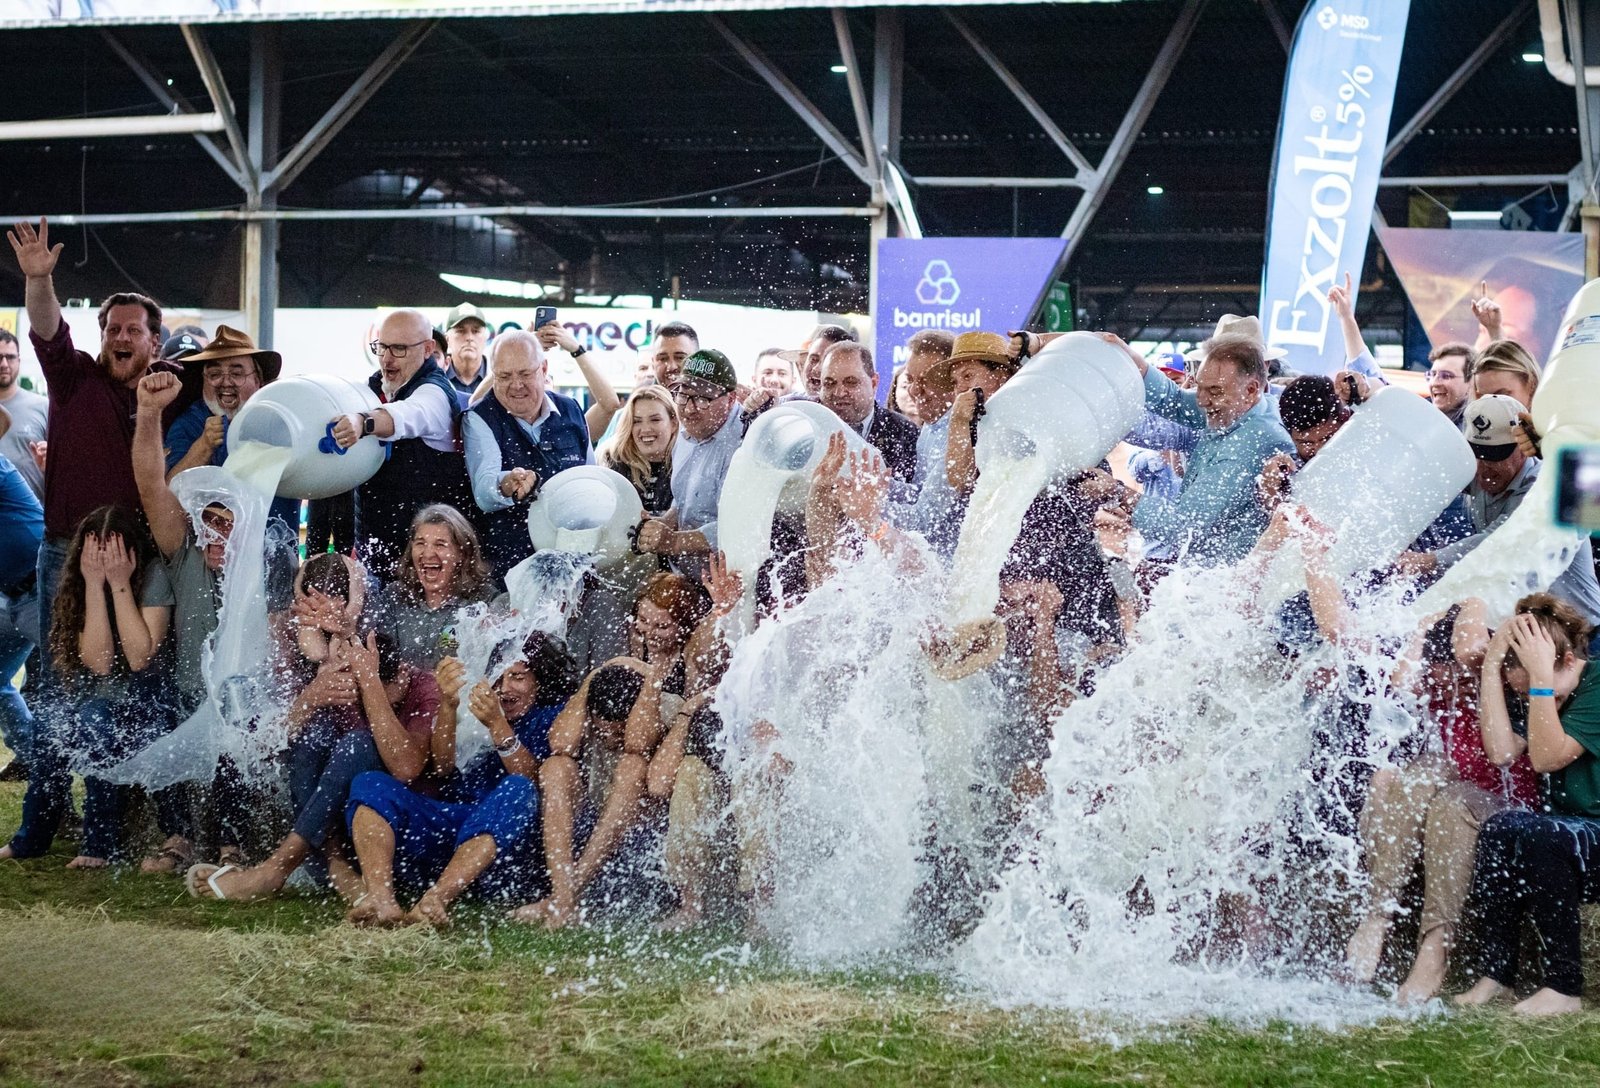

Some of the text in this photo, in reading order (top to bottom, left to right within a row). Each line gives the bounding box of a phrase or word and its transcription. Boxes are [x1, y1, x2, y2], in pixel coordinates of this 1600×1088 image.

[1340, 14, 1369, 29] MSD
[1335, 65, 1374, 128] 5%
[893, 307, 981, 328] banrisul
